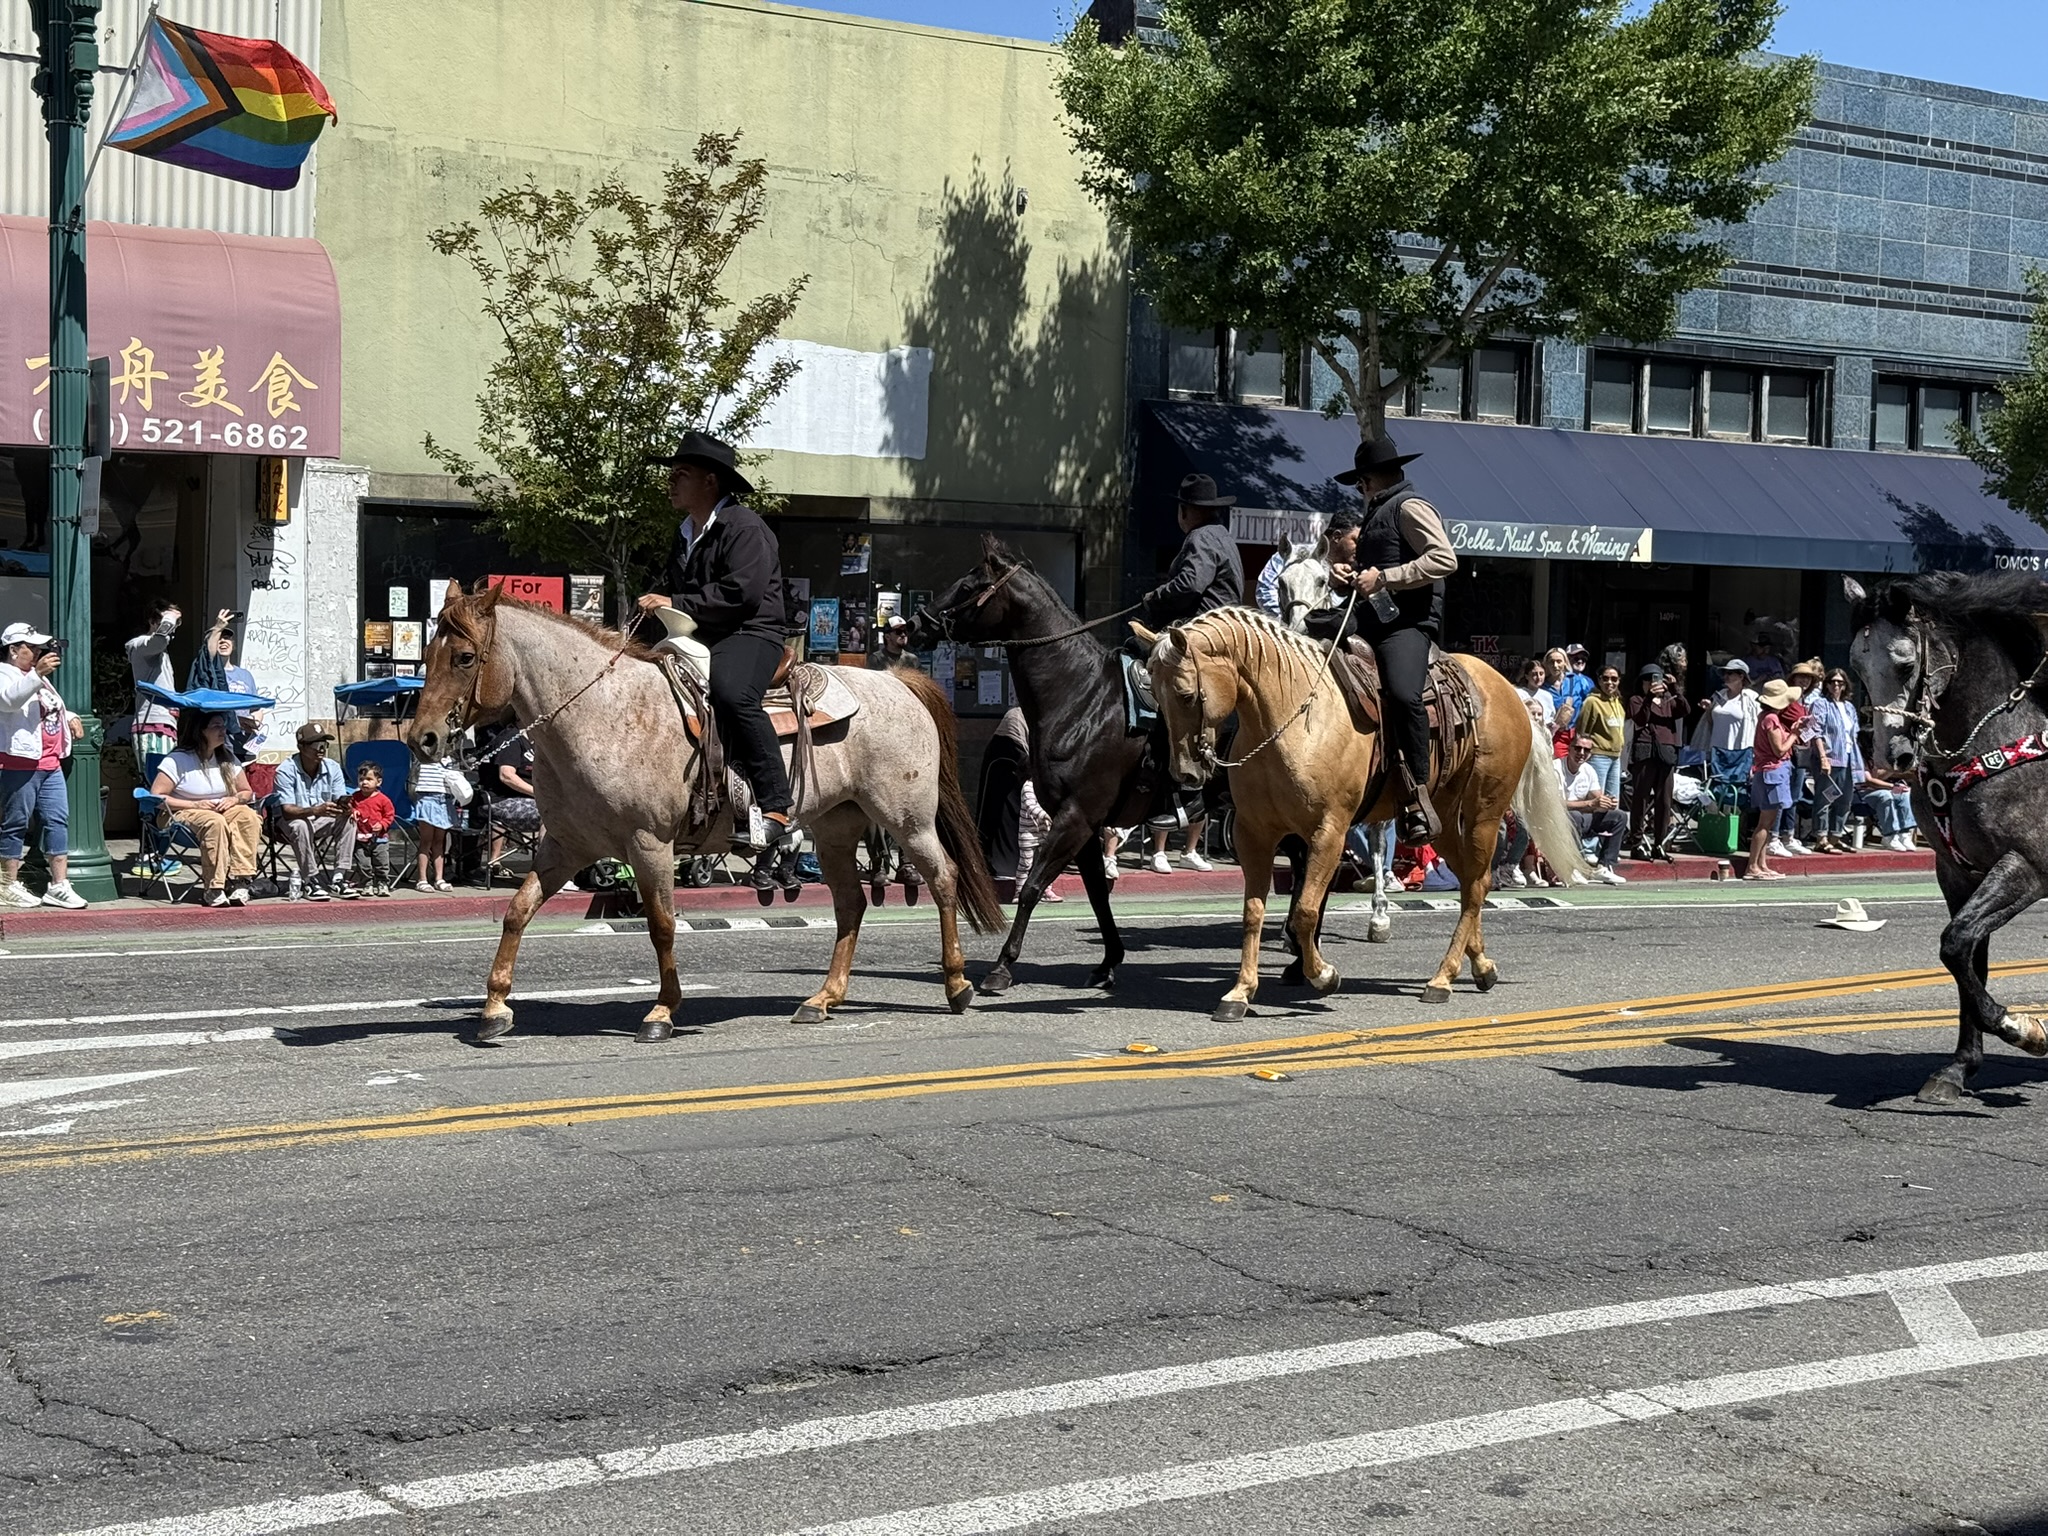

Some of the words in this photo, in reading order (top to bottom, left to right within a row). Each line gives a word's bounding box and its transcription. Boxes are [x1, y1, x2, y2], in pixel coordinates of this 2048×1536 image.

[141, 417, 309, 450] 521-6862
[1236, 515, 1288, 543] LITTLE
[1451, 523, 1496, 550] Bella
[1496, 525, 1535, 552] Nail
[1536, 528, 1563, 557] Spa
[1567, 529, 1579, 554] &
[1581, 529, 1631, 560] Waxing
[1994, 554, 2040, 571] TOMO'S
[511, 579, 542, 594] For
[1470, 635, 1499, 653] TK
